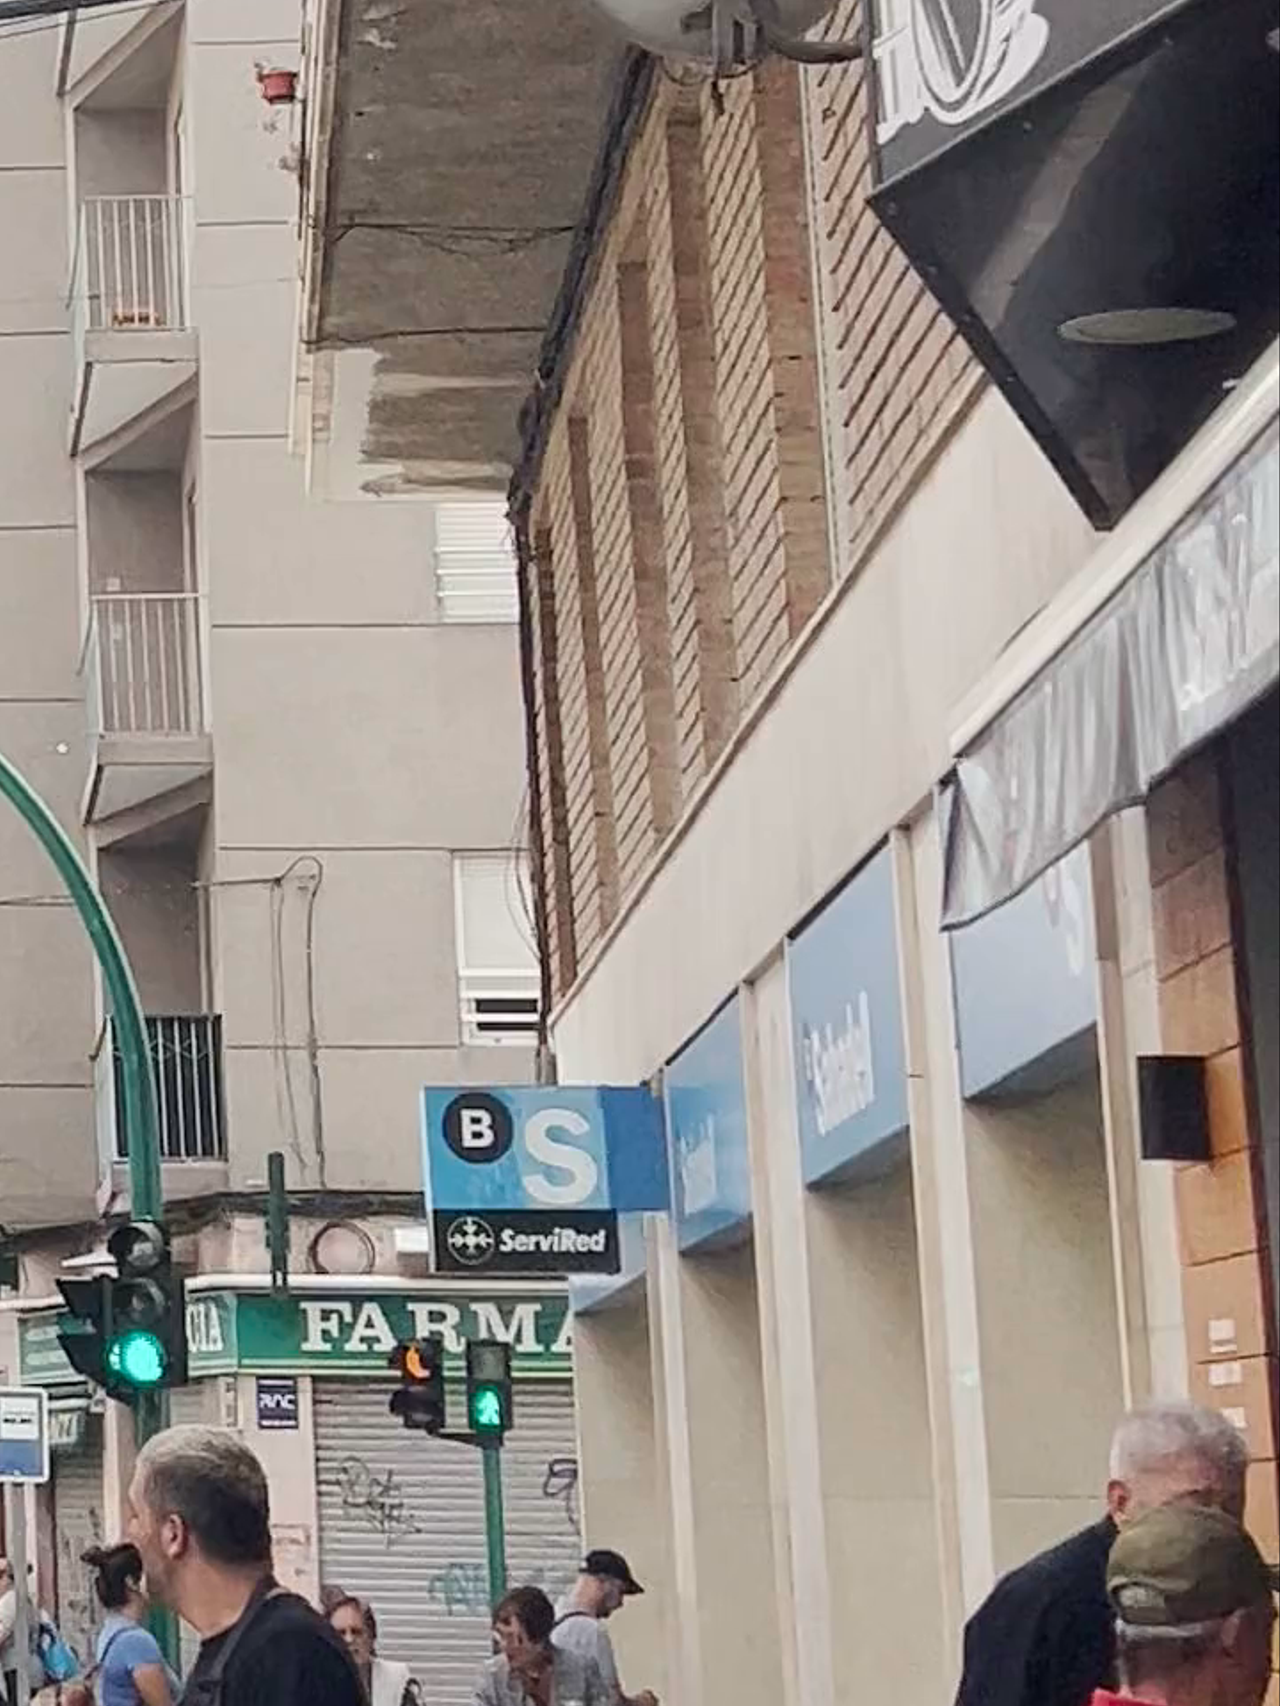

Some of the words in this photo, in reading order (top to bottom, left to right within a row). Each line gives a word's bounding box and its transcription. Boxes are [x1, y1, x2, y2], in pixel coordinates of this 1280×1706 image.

[460, 1108, 495, 1149] B
[523, 1108, 598, 1205] S
[499, 1227, 607, 1254] ServiRed
